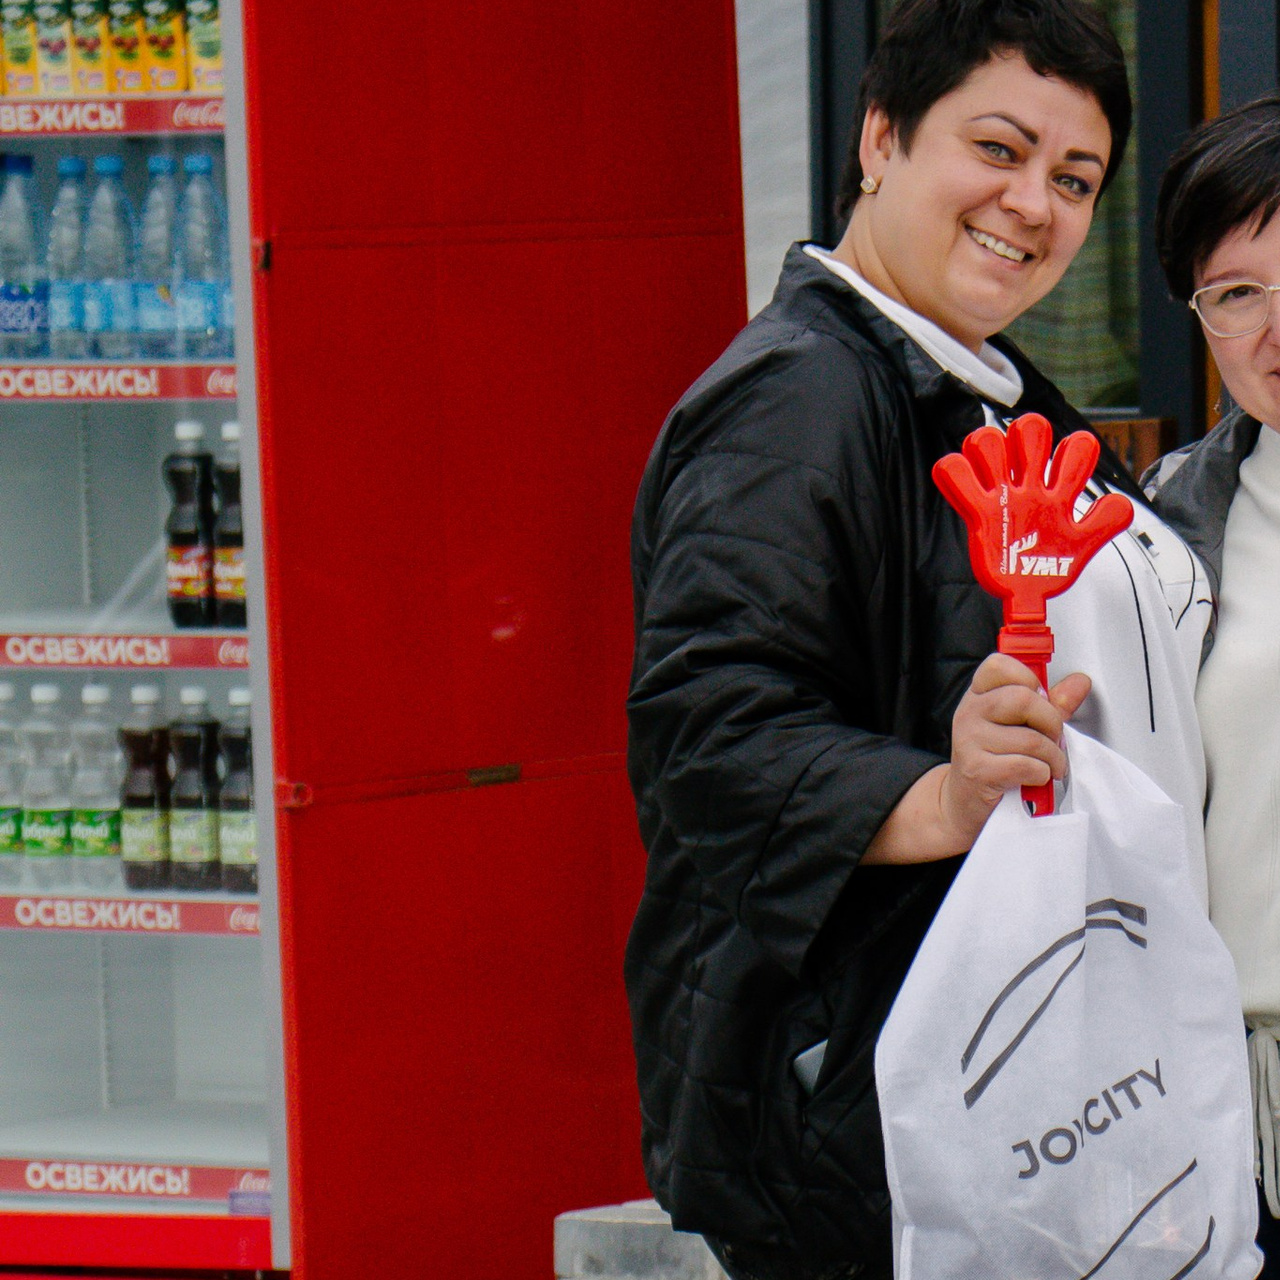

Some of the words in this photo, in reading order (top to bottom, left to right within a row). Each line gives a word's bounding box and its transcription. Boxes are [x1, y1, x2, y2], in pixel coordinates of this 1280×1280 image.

[0, 369, 160, 398] ОСВЕЖИСЬ!
[5, 637, 170, 665] ОСВЕЖИСЬ!
[15, 901, 181, 930] ОСВЕЖИСЬ!
[25, 1162, 191, 1196] ОСВЕЖИСЬ!
